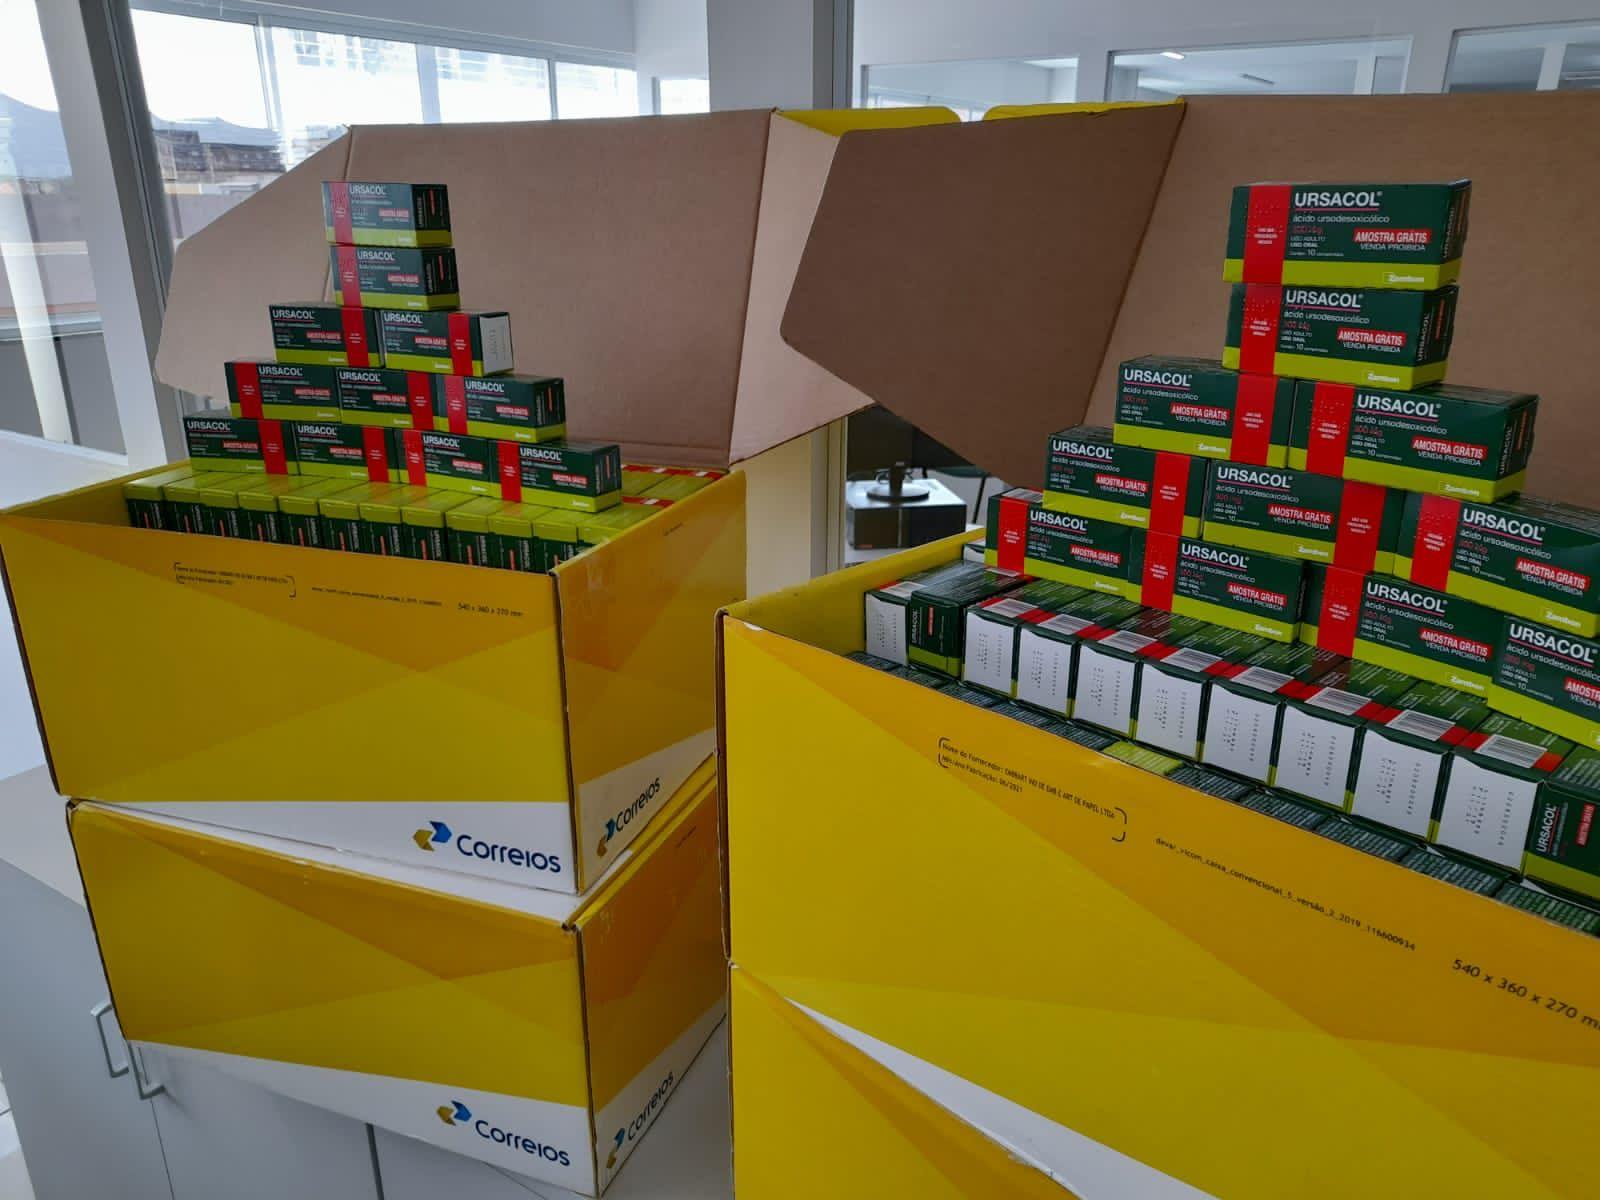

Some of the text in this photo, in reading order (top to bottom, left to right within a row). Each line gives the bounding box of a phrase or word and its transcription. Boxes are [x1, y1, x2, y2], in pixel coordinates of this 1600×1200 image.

[1355, 231, 1427, 242] AMOSTRA GRÁTIS
[1338, 330, 1402, 345] AMOSTRA GRÁTIS
[1171, 405, 1227, 419] AMOSTRA GRÁTIS
[1413, 438, 1483, 458] AMOSTRA GRÁTIS
[1096, 475, 1123, 487] AMOSTRA
[1269, 506, 1330, 523] AMOSTRA GRÁTIS
[1460, 528, 1481, 540] ácido
[1071, 546, 1097, 558] AMOSTRA
[1517, 560, 1586, 588] AMOSTRA GRÁTIS
[1228, 584, 1258, 599] AMOSTRA
[1421, 629, 1487, 656] AMOSTRA GRÁTIS
[615, 777, 661, 832] Correios
[456, 834, 562, 874] Correios
[1452, 959, 1481, 977] 540
[1483, 974, 1494, 984] x
[1497, 977, 1528, 998] 360
[1530, 994, 1542, 1004] x
[1545, 998, 1577, 1018] 270
[627, 1071, 675, 1142] Correios
[474, 1119, 571, 1167] Correios
